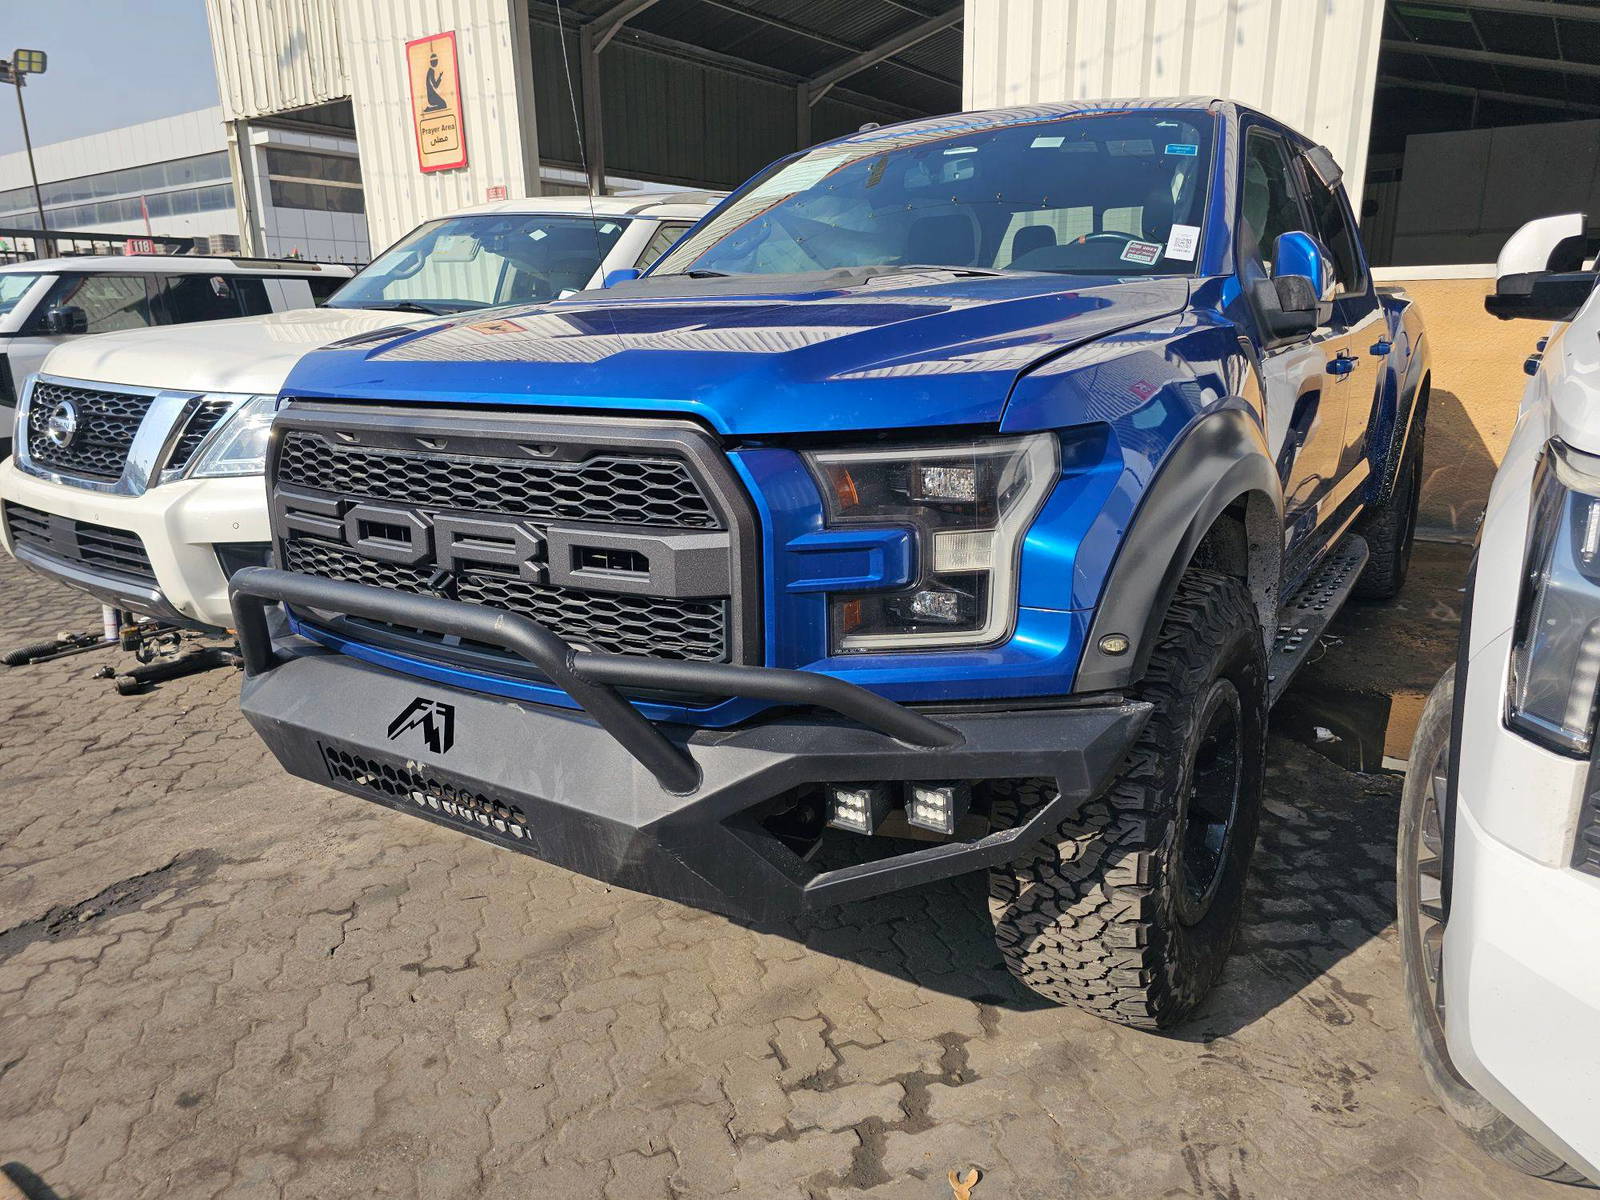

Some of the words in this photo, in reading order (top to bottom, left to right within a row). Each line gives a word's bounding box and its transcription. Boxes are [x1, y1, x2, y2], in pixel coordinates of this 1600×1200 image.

[422, 127, 440, 135] Prayer
[441, 124, 455, 132] Area
[132, 240, 150, 252] 118
[275, 492, 684, 598] FORD
